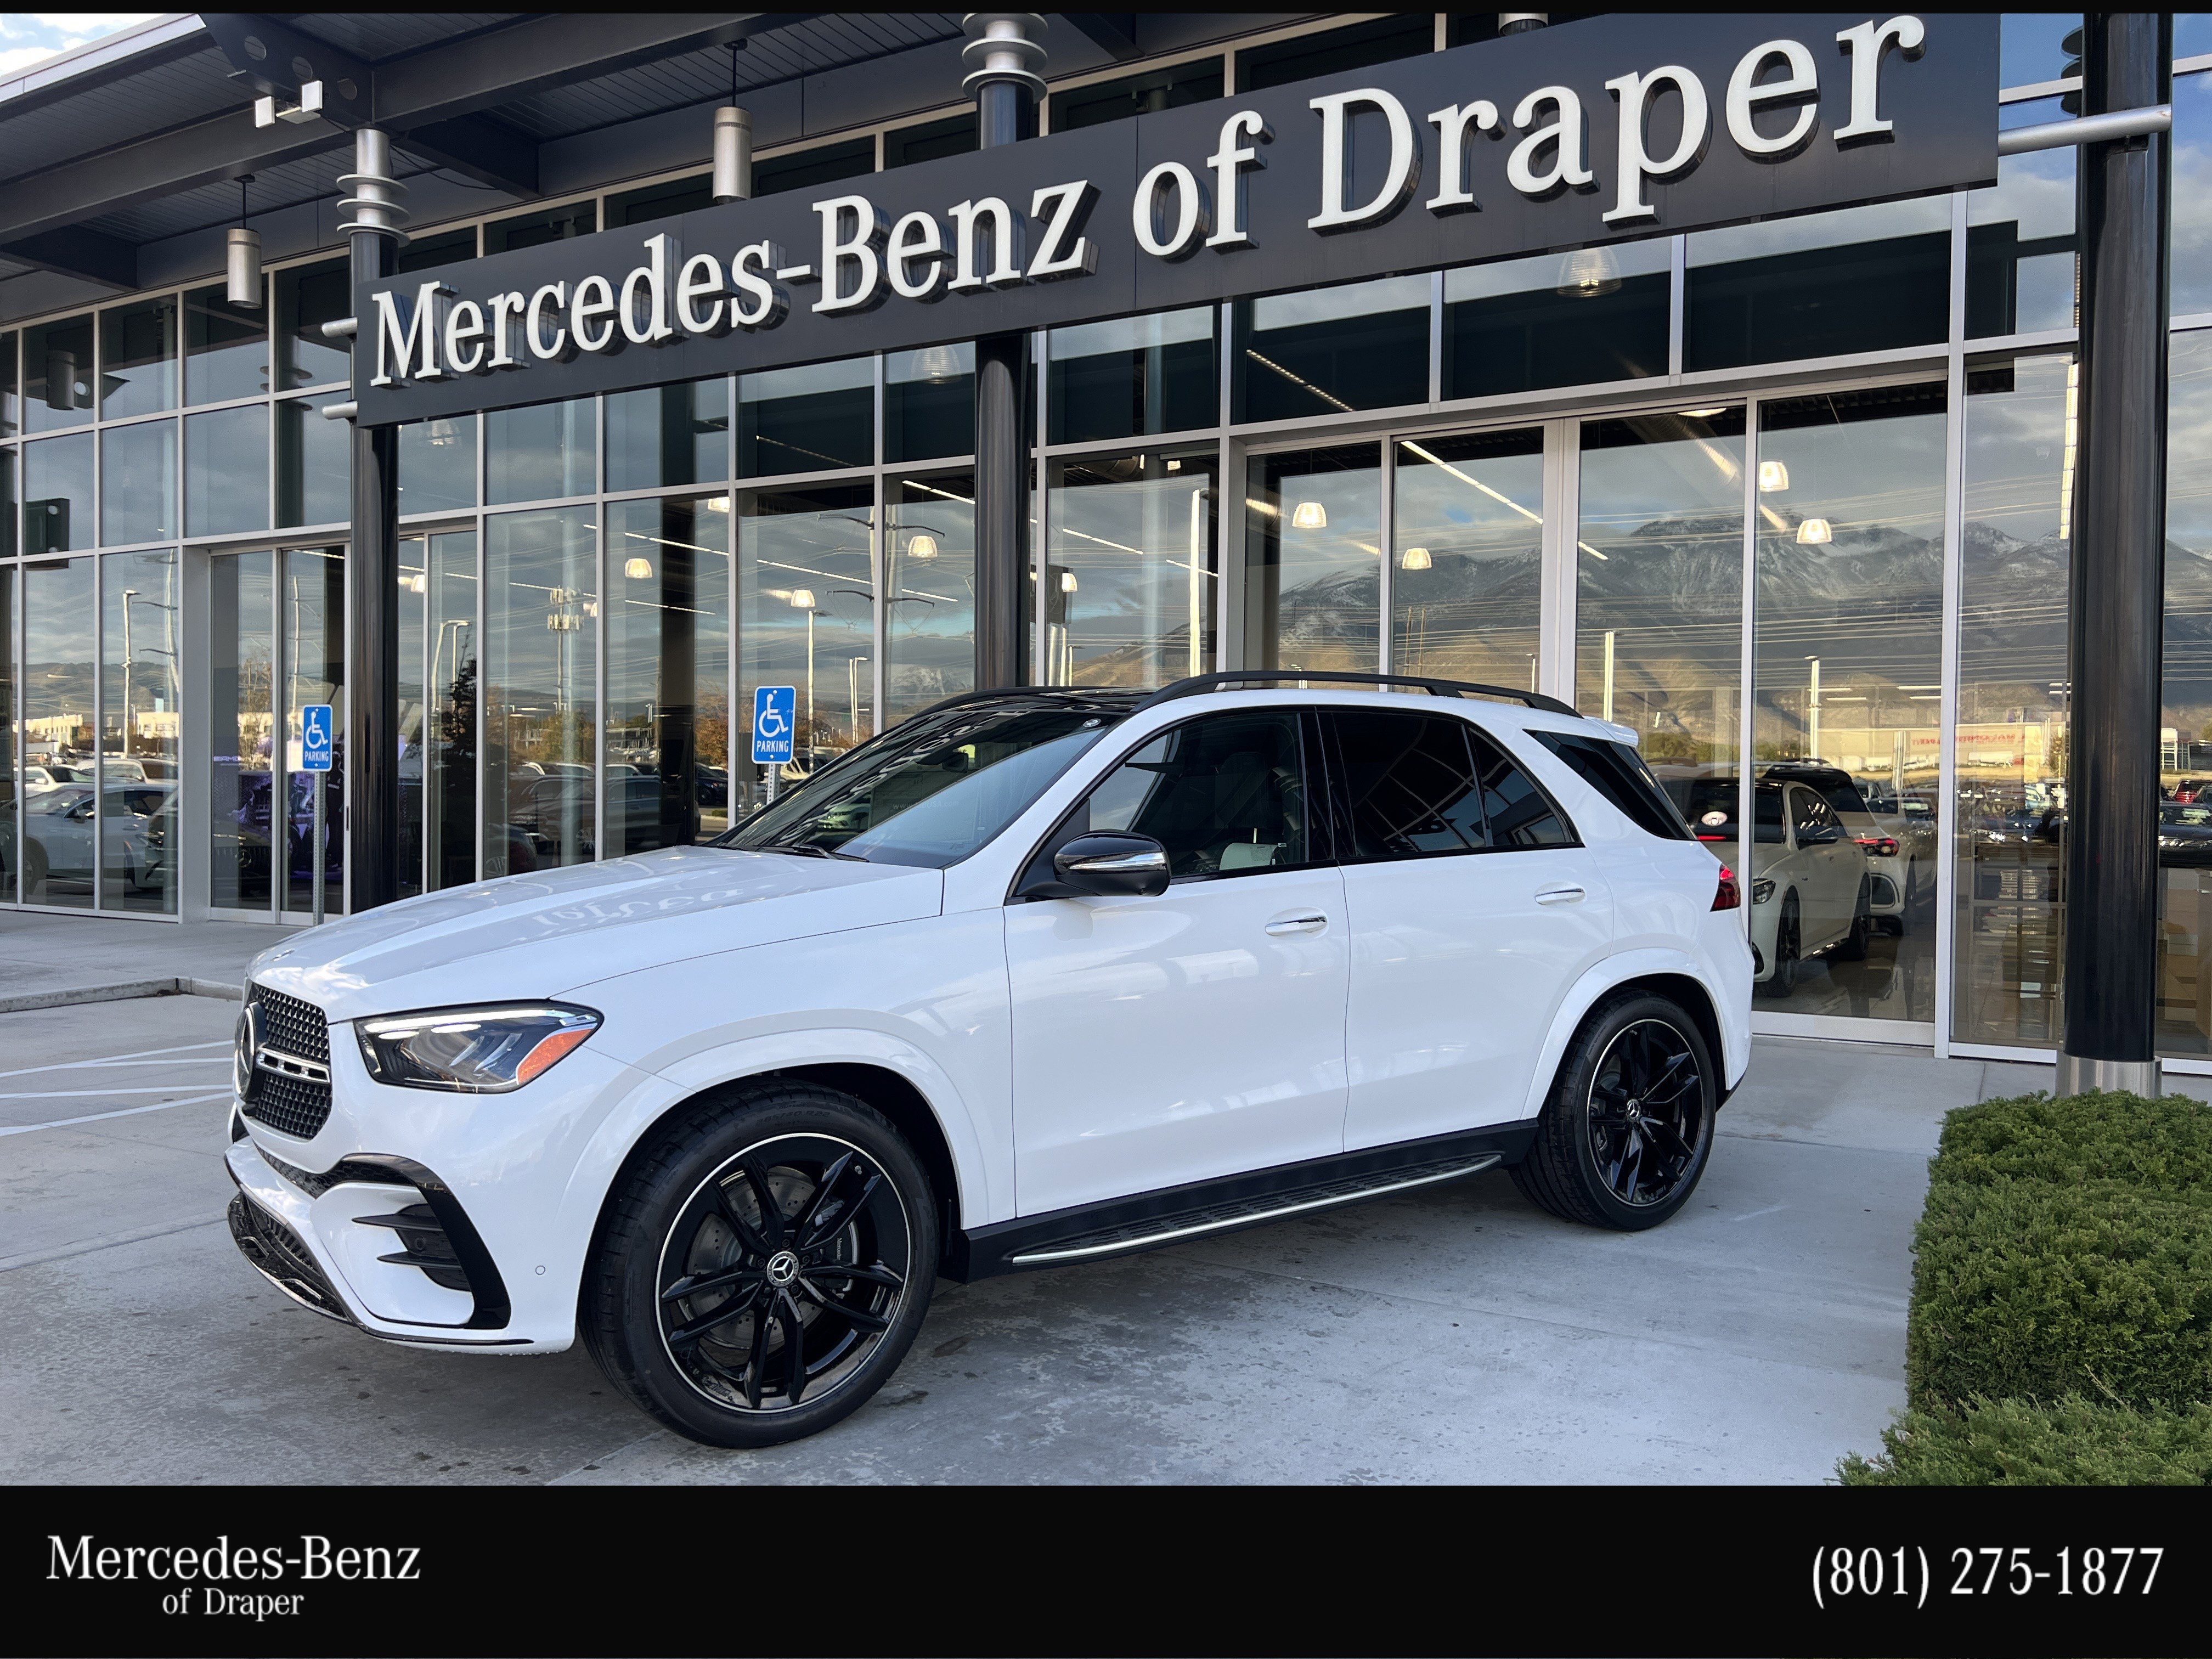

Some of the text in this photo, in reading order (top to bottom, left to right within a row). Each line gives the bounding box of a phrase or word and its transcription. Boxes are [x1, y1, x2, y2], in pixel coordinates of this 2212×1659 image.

[370, 15, 1925, 386] Mercedes-Benz of Draper
[757, 740, 789, 752] PARKING
[304, 751, 329, 761] PARKING
